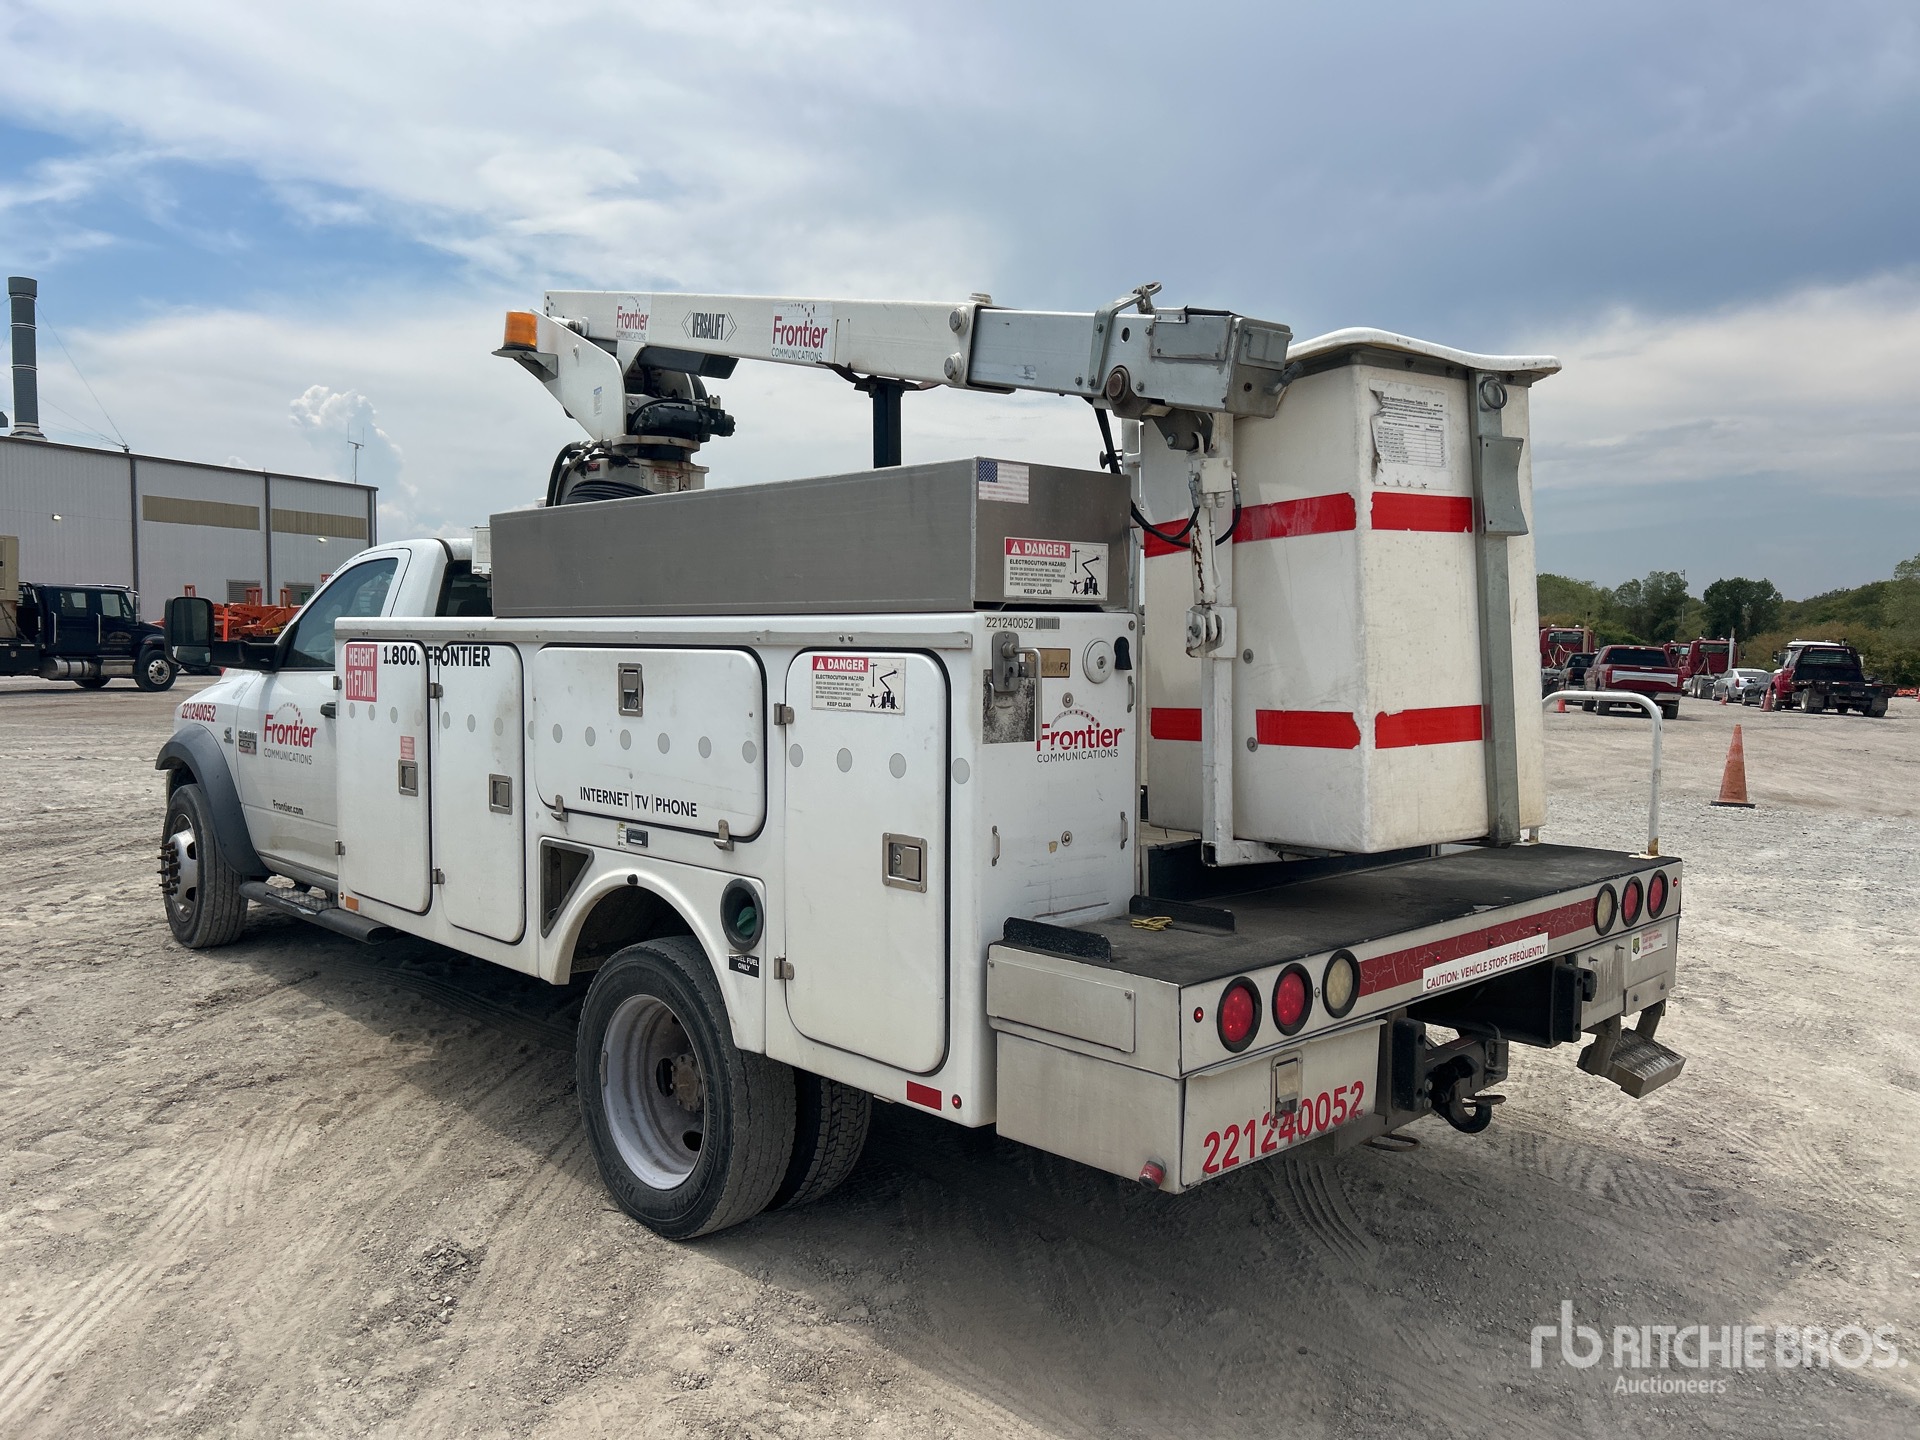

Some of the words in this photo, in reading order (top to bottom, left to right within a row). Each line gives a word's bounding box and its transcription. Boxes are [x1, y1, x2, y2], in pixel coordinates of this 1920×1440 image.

[616, 305, 649, 331] Frontier
[692, 312, 726, 341] VERSALIFT
[773, 315, 828, 349] Frontier
[771, 347, 823, 361] COMMUNICATIONS
[1024, 542, 1066, 556] DANGER
[1009, 559, 1048, 567] ELECTROCUTION
[986, 617, 1034, 629] 221240052
[348, 648, 375, 667] HEIGHT
[426, 646, 491, 667] FRONTIER
[827, 658, 865, 671] DANGER
[815, 673, 848, 681] ELECTROCUTION
[181, 702, 217, 722] 221240052
[264, 714, 317, 748] Frontier
[1036, 723, 1124, 752] Frontier
[264, 748, 313, 765] COMMUNICATIONS
[1036, 748, 1119, 763] COMMUNICATIONS
[272, 799, 304, 815] Frontier.com
[580, 786, 629, 807] INTERNET
[634, 794, 649, 810] TV
[655, 797, 698, 818] PHONE
[737, 962, 751, 971] ONLY
[746, 957, 759, 967] FUEL
[1426, 969, 1460, 990] CAUTION:
[1460, 961, 1488, 979] VEHICLE
[1488, 954, 1508, 971] STOPS
[1508, 943, 1547, 964] FREQUENTLY
[1202, 1080, 1365, 1175] 221240052
